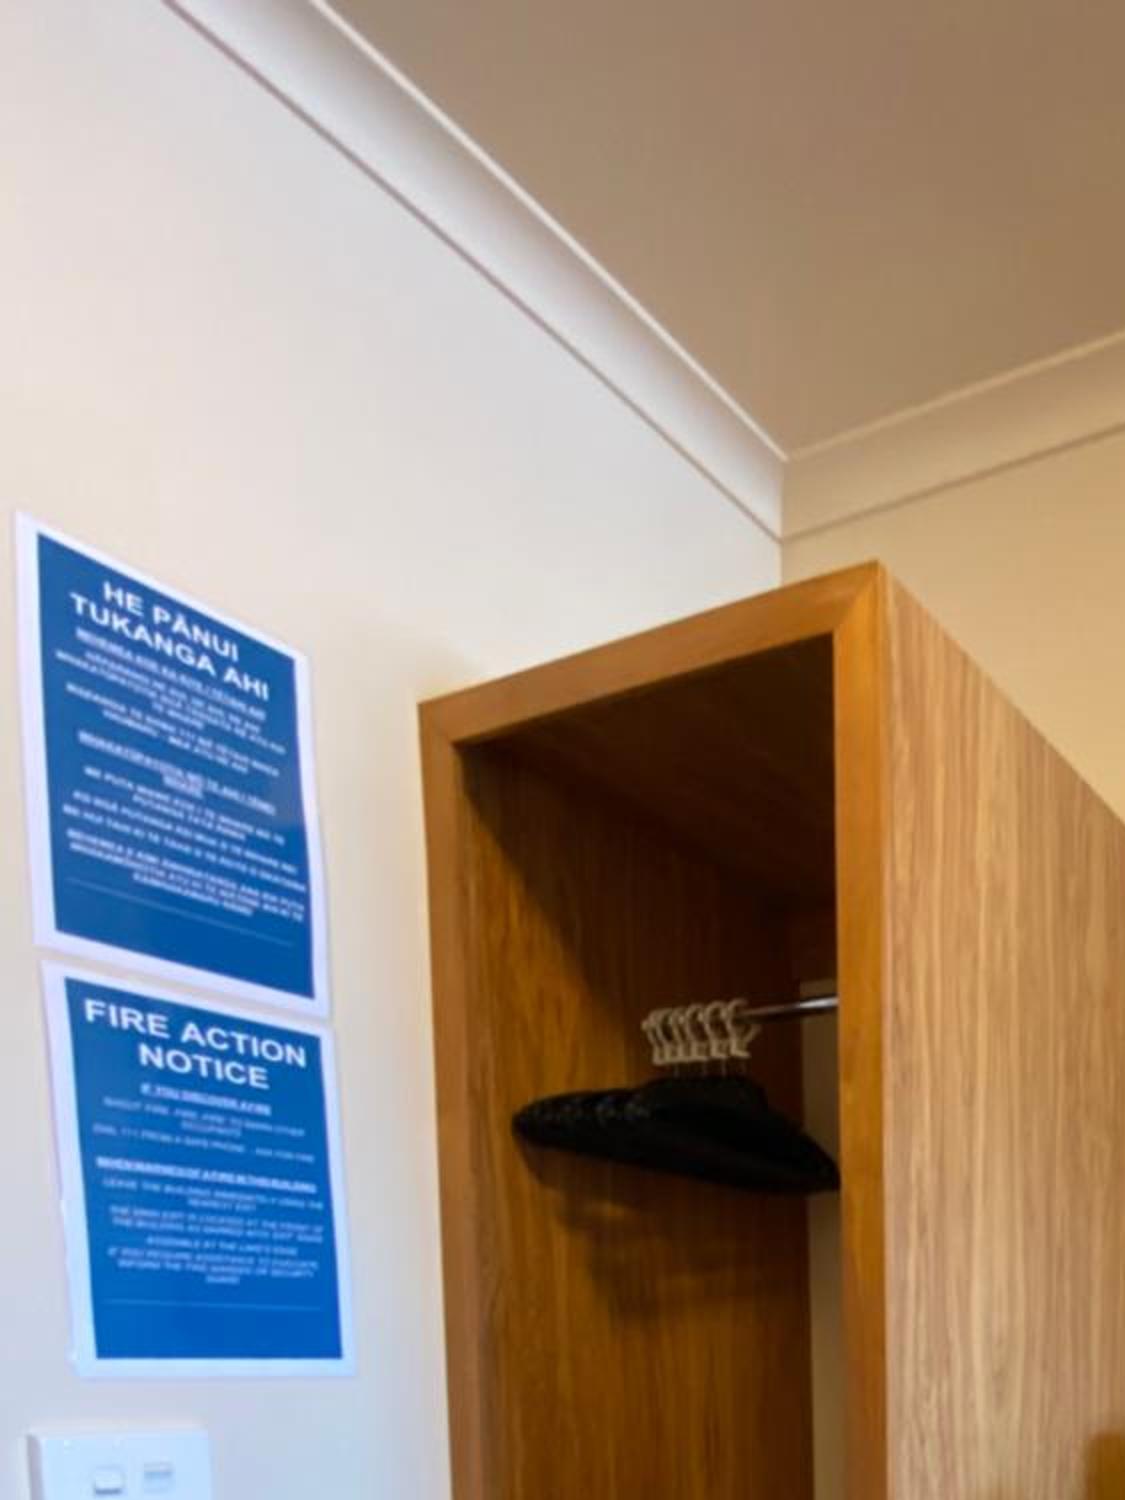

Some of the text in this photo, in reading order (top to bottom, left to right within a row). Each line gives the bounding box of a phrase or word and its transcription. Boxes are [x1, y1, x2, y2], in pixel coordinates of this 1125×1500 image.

[103, 580, 143, 617] HE
[69, 590, 216, 677] TUKANGA
[223, 667, 269, 701] AHI
[84, 998, 307, 1067] FIRE ACTION
[138, 1043, 269, 1090] NOTICE
